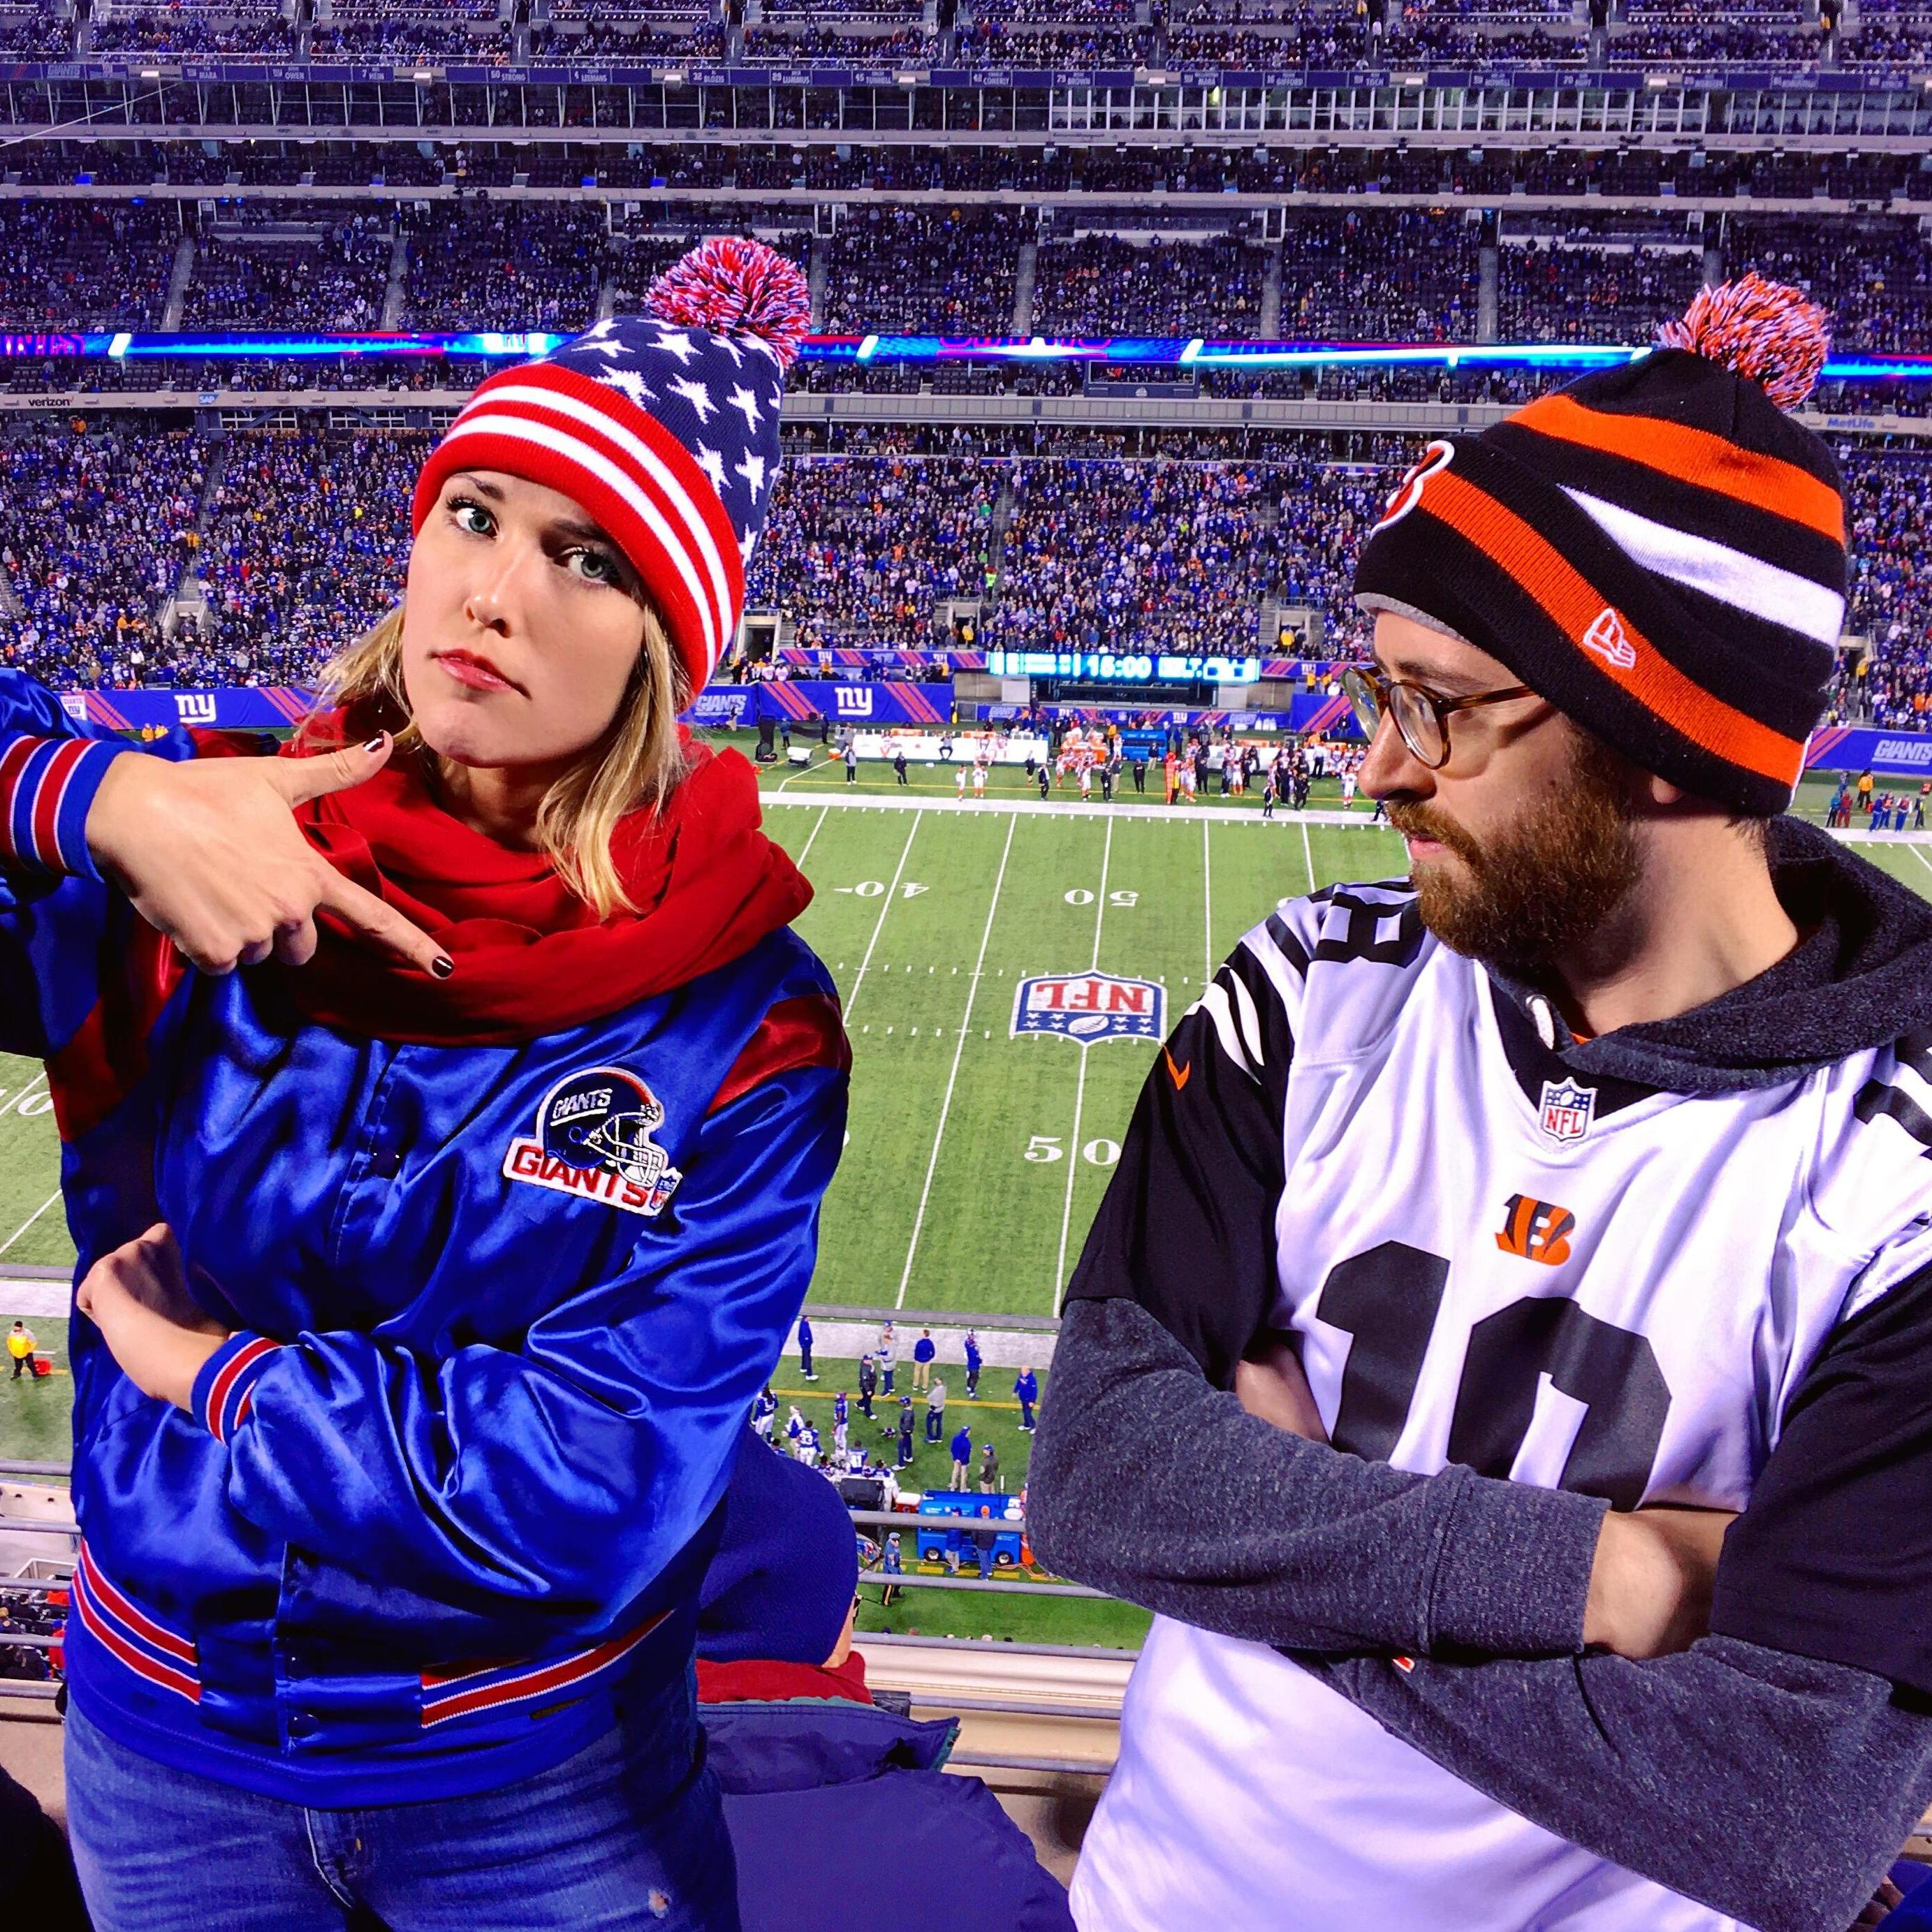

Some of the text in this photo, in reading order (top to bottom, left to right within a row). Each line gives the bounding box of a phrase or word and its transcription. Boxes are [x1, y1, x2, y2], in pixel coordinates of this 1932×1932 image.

[28, 397, 70, 407] verizon
[1827, 416, 1873, 428] MetLife
[174, 694, 217, 722] ny
[696, 694, 747, 712] GIANTS
[834, 687, 873, 715] ny
[1873, 739, 1932, 762] GIANTS
[1036, 980, 1148, 1013] NFL
[552, 1088, 613, 1118] GIANTS
[1545, 1107, 1582, 1136] NFL
[511, 1145, 650, 1208] GIANTS
